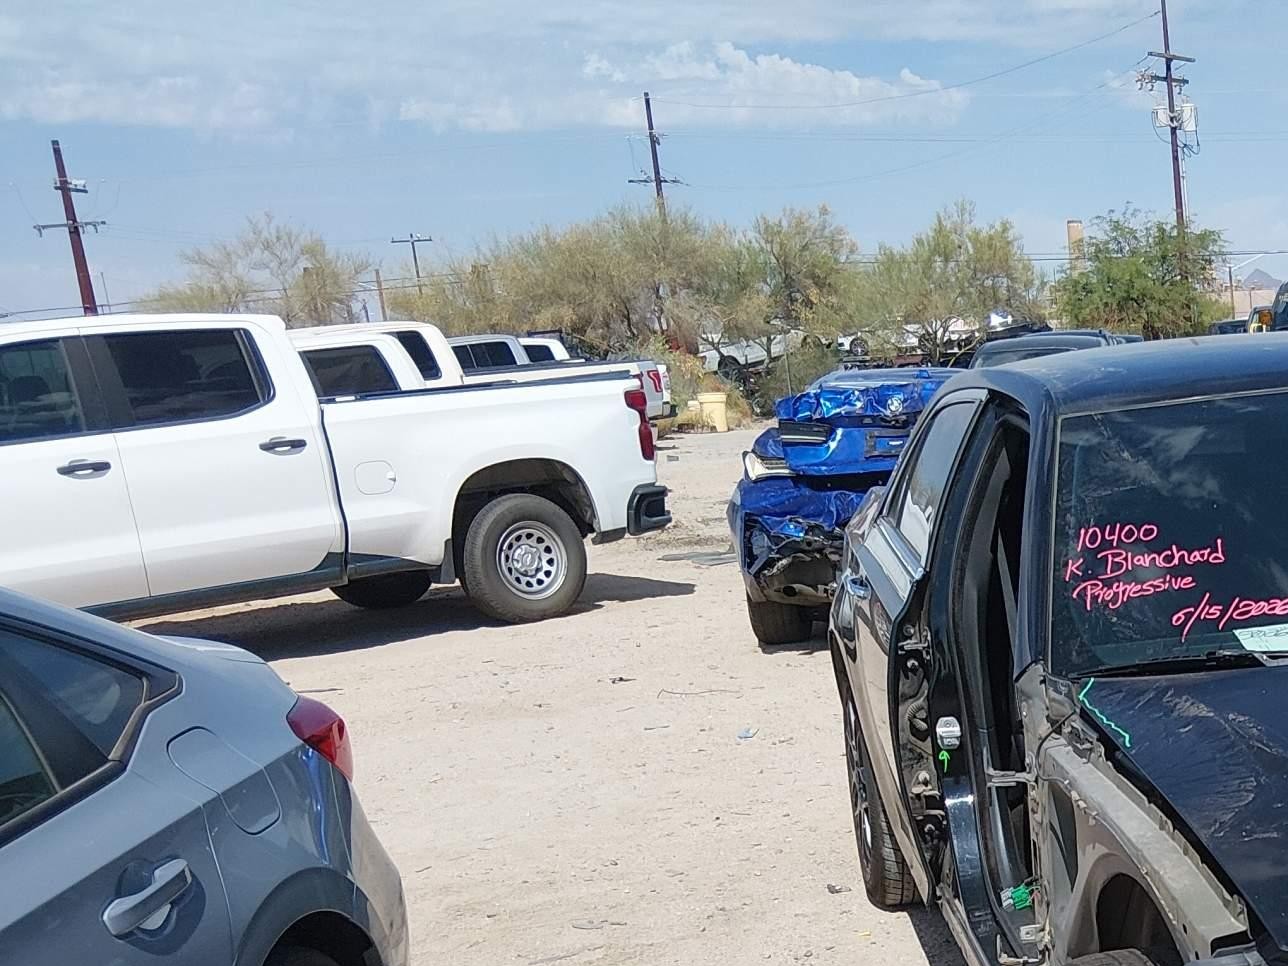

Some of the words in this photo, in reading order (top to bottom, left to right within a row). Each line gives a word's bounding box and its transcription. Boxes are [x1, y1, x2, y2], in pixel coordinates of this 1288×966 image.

[1076, 522, 1159, 551] 10400
[1097, 537, 1226, 579] Blanchard
[1071, 574, 1197, 610] Progressive
